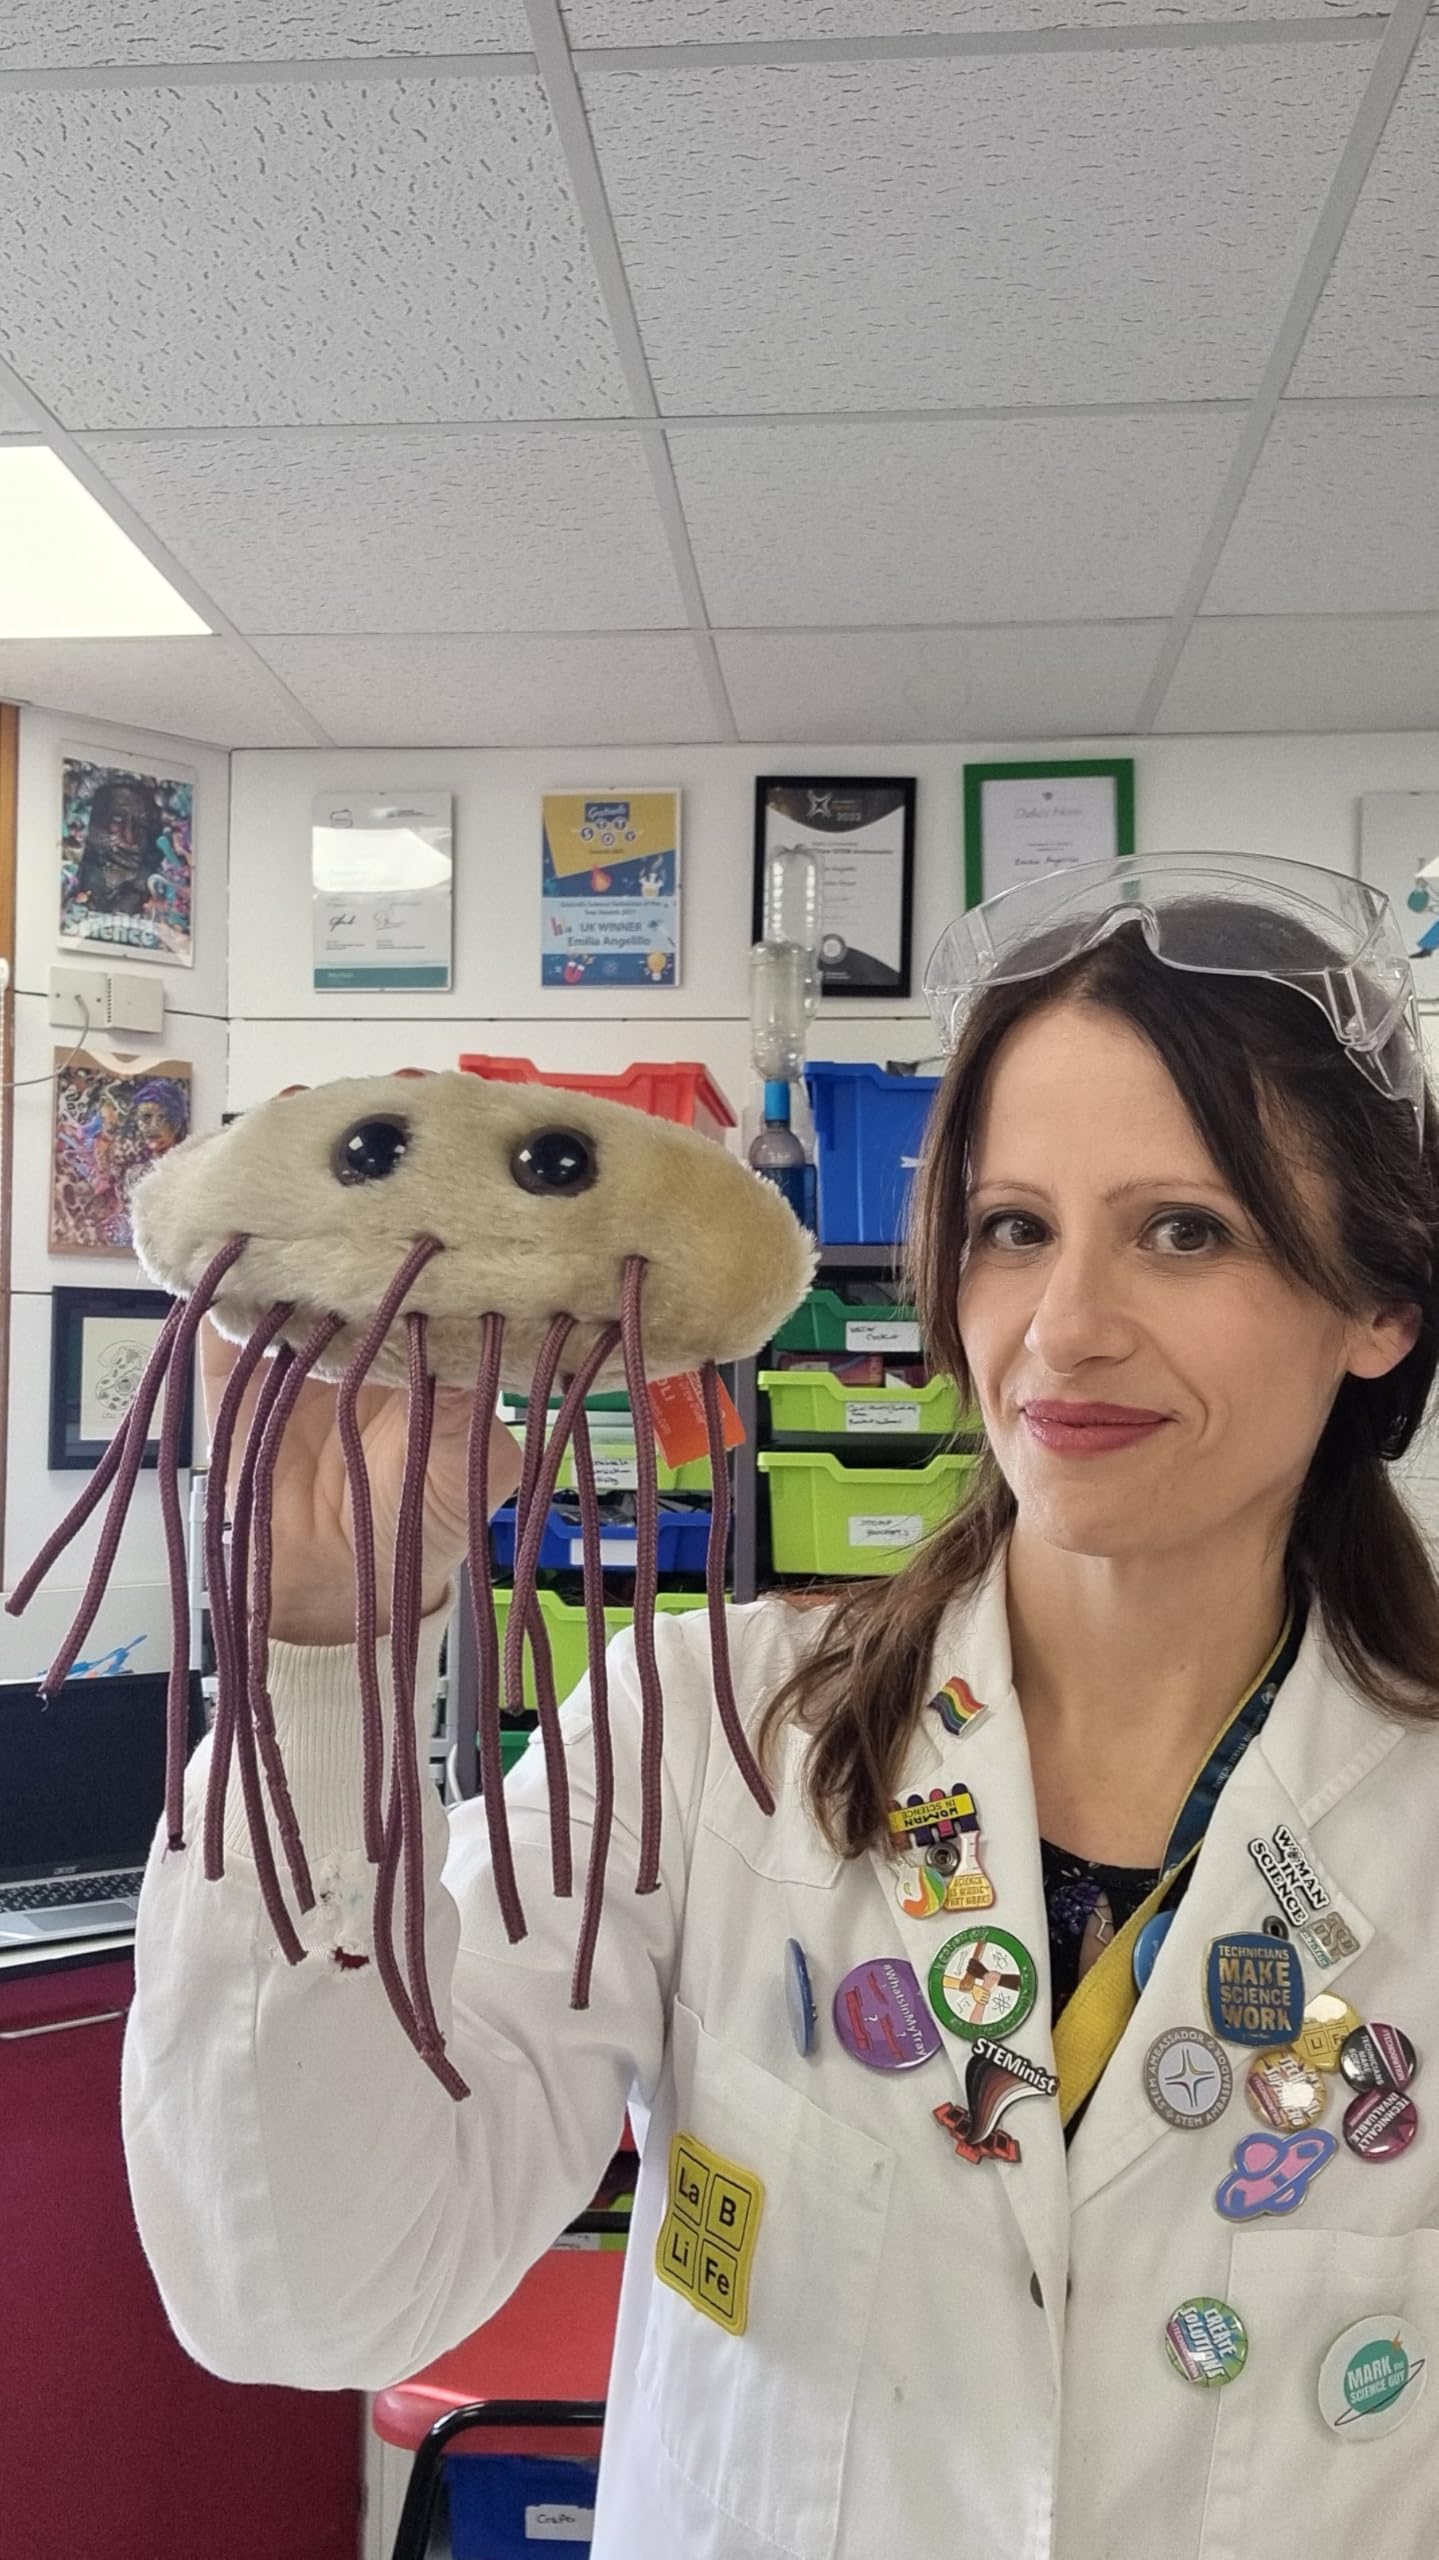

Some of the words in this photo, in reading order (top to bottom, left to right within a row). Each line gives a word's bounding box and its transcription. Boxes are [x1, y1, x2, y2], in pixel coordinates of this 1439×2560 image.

[597, 922, 642, 932] WINNER
[902, 1801, 943, 1818] SCIENCE
[904, 1807, 958, 1828] WOMAN
[944, 1799, 957, 1807] IN
[1252, 1841, 1307, 1923] SCIENCE
[1281, 1862, 1300, 1888] IN
[1218, 1945, 1289, 1959] TECHNICIANS
[1219, 1958, 1291, 1988] MAKE
[884, 1964, 928, 2057] #WhatsInMyTray
[1220, 1986, 1292, 2006] SCIENCE
[1220, 2004, 1292, 2031] WORK
[974, 2038, 1057, 2094] STEMinist
[1359, 2034, 1385, 2086] TECHNICIANS
[1279, 2056, 1322, 2118] TECHAL
[1350, 2092, 1399, 2143] INVALUABLE
[1359, 2097, 1410, 2152] TECHNICALLY
[678, 2166, 700, 2204] La
[718, 2195, 737, 2227] B
[671, 2232, 689, 2267] Li
[705, 2256, 730, 2296] Fe
[1178, 2305, 1226, 2379] SOLUTIONS
[1204, 2307, 1237, 2358] CREATE
[1347, 2355, 1393, 2390] MARK
[1350, 2379, 1388, 2404] SCIENCE
[1388, 2369, 1407, 2390] GUY
